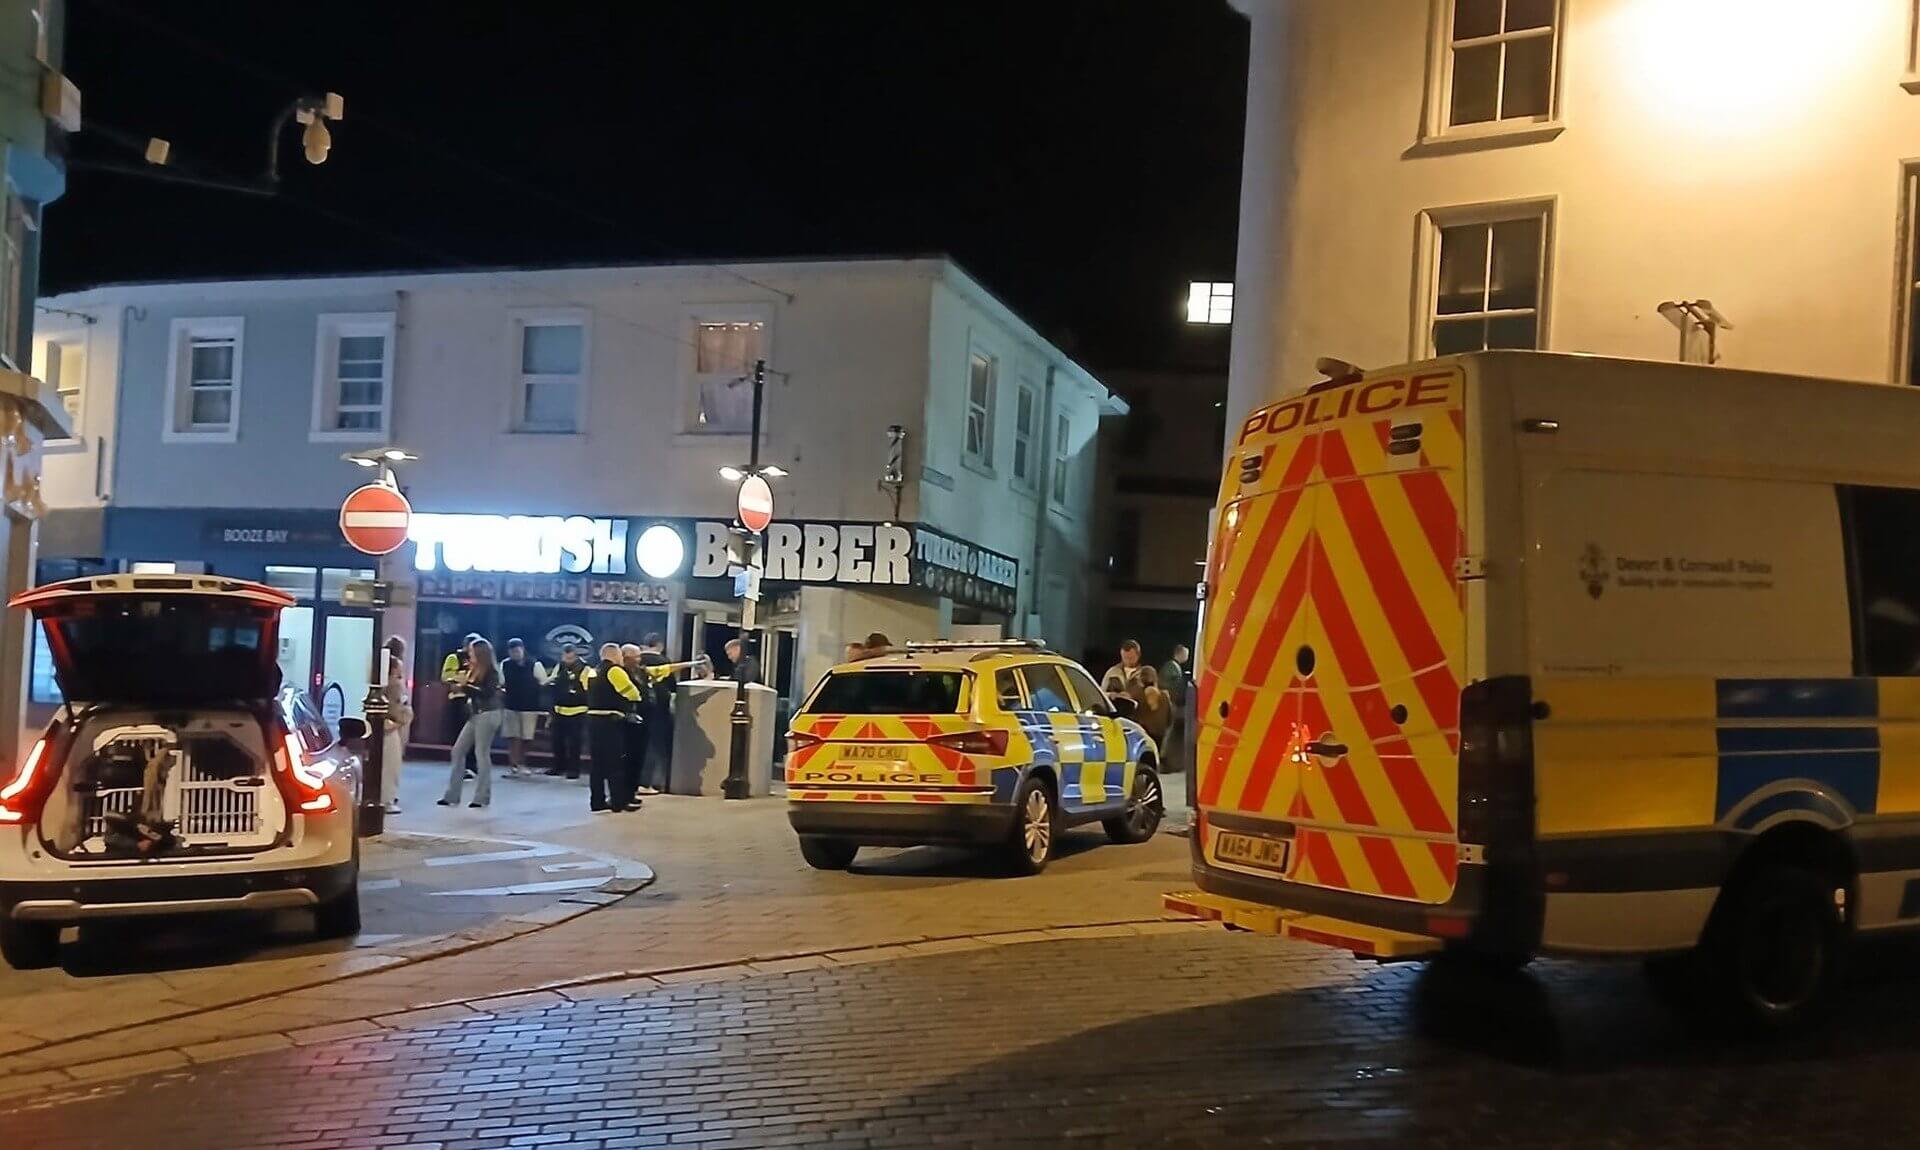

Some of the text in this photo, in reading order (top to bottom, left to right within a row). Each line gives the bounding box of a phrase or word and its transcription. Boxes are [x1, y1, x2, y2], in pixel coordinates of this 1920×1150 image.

[1239, 372, 1454, 446] POLICE
[224, 529, 263, 542] BOOZE
[266, 530, 288, 542] BAY
[916, 529, 969, 574] TURKISH
[805, 772, 943, 784] POLICE
